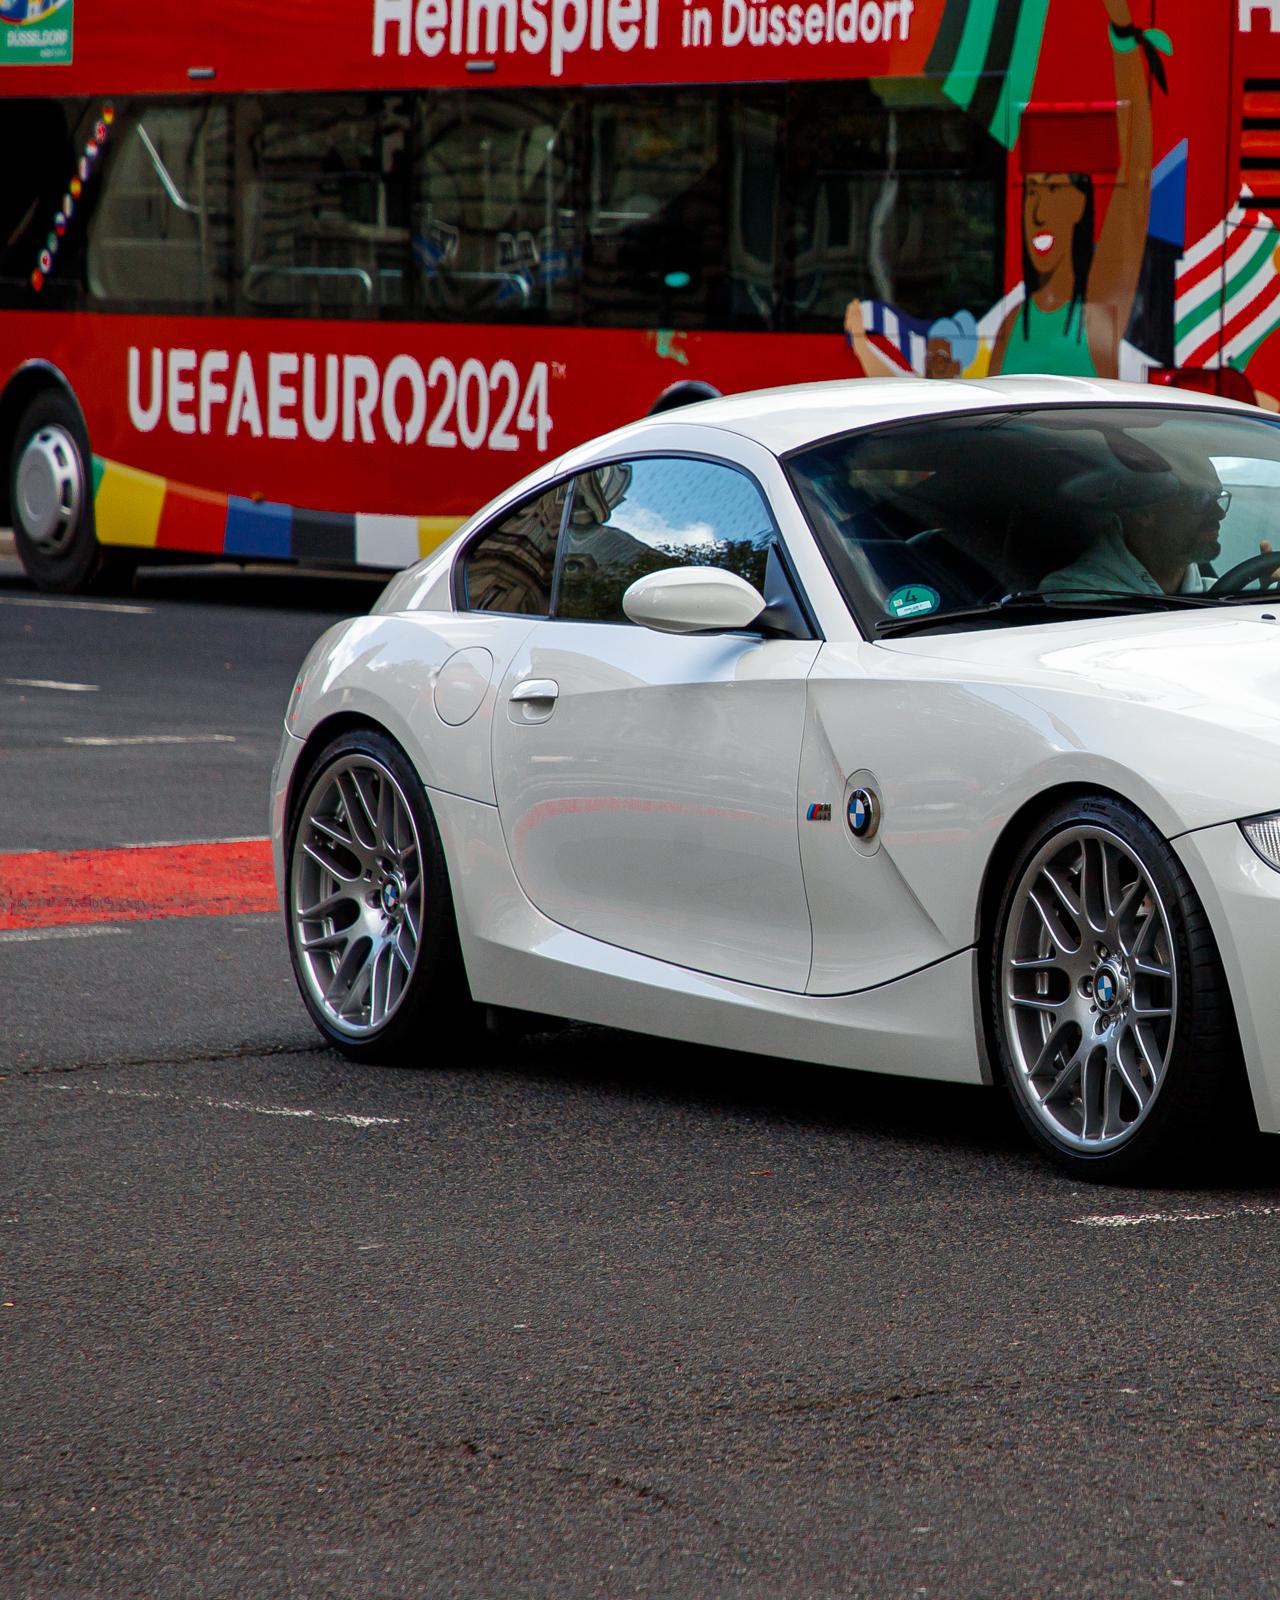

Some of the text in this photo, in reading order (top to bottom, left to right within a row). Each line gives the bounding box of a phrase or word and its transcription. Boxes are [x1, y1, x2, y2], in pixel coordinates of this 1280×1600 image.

[682, 0, 712, 48] in
[722, 0, 914, 47] Düsseldorf
[905, 589, 918, 603] 4
